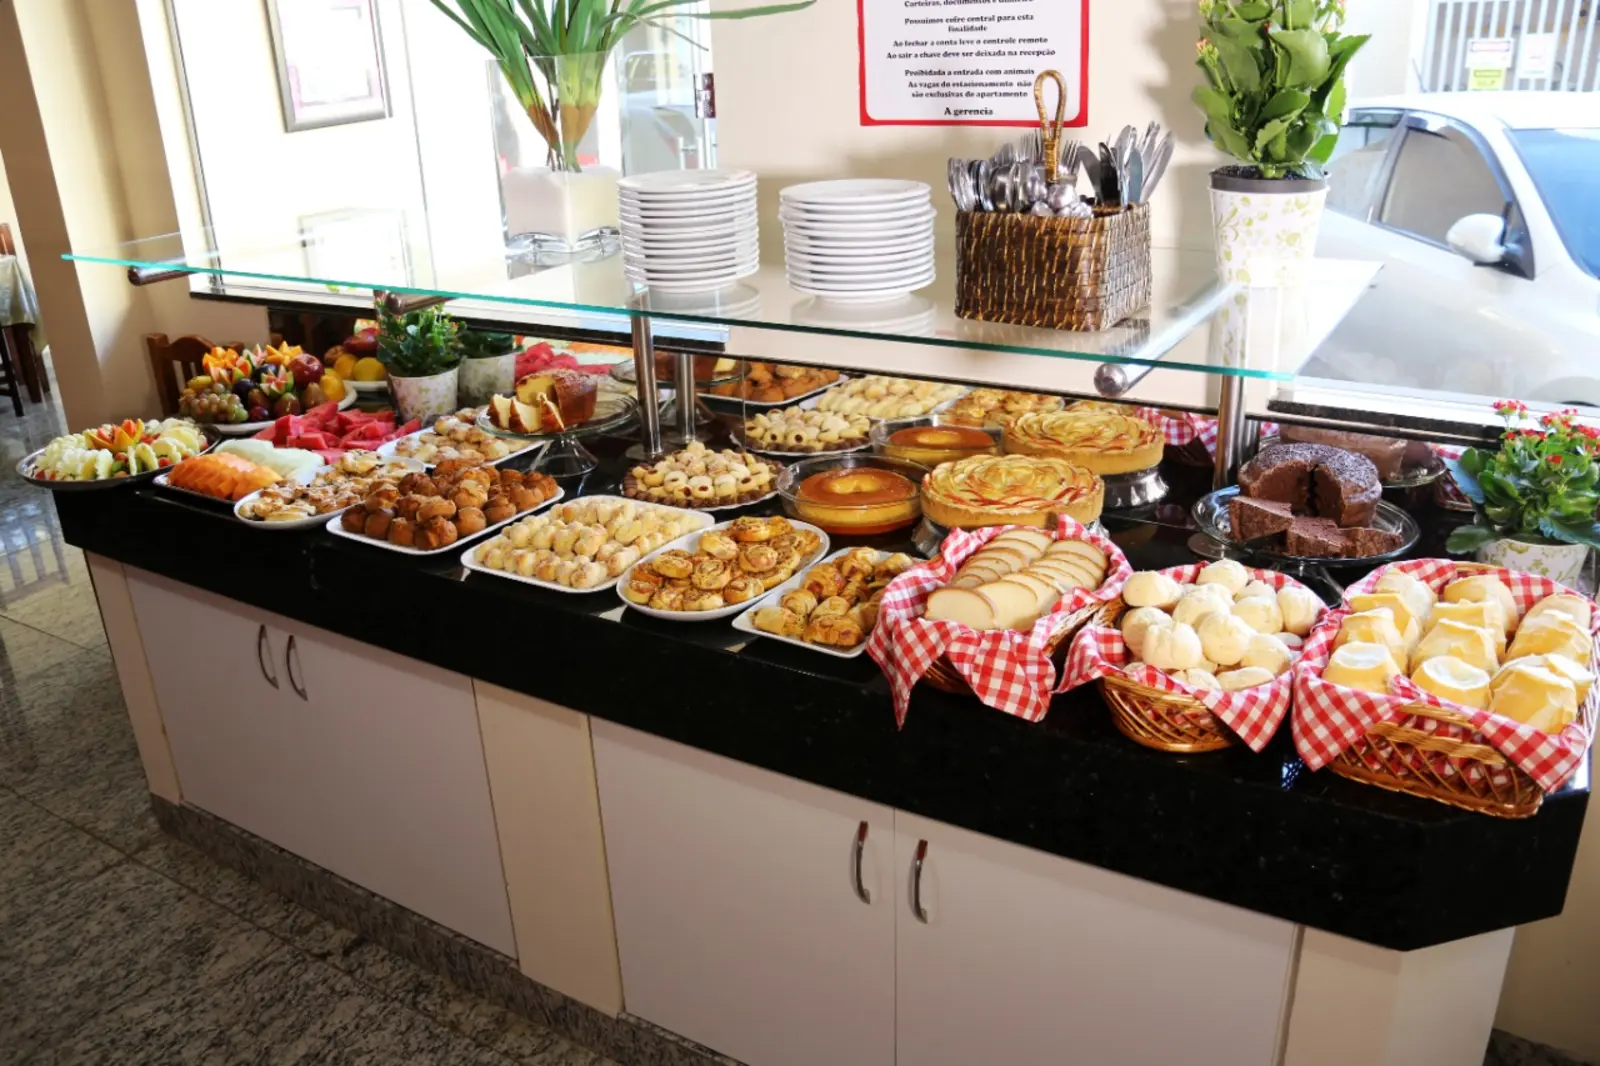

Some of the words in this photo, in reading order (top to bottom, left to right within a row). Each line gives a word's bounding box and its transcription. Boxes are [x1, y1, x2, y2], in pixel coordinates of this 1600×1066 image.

[904, 0, 942, 8] Carteiras,
[967, 14, 995, 22] central
[997, 14, 1015, 23] para
[948, 24, 988, 33] finalidade
[905, 39, 928, 47] fechar
[983, 37, 1016, 45] controle
[942, 50, 960, 58] deve
[1019, 48, 1056, 57] recepção
[925, 90, 964, 98] exclusivas
[976, 91, 1028, 99] apartamento
[944, 107, 952, 115] A
[953, 106, 994, 117] gerencia
